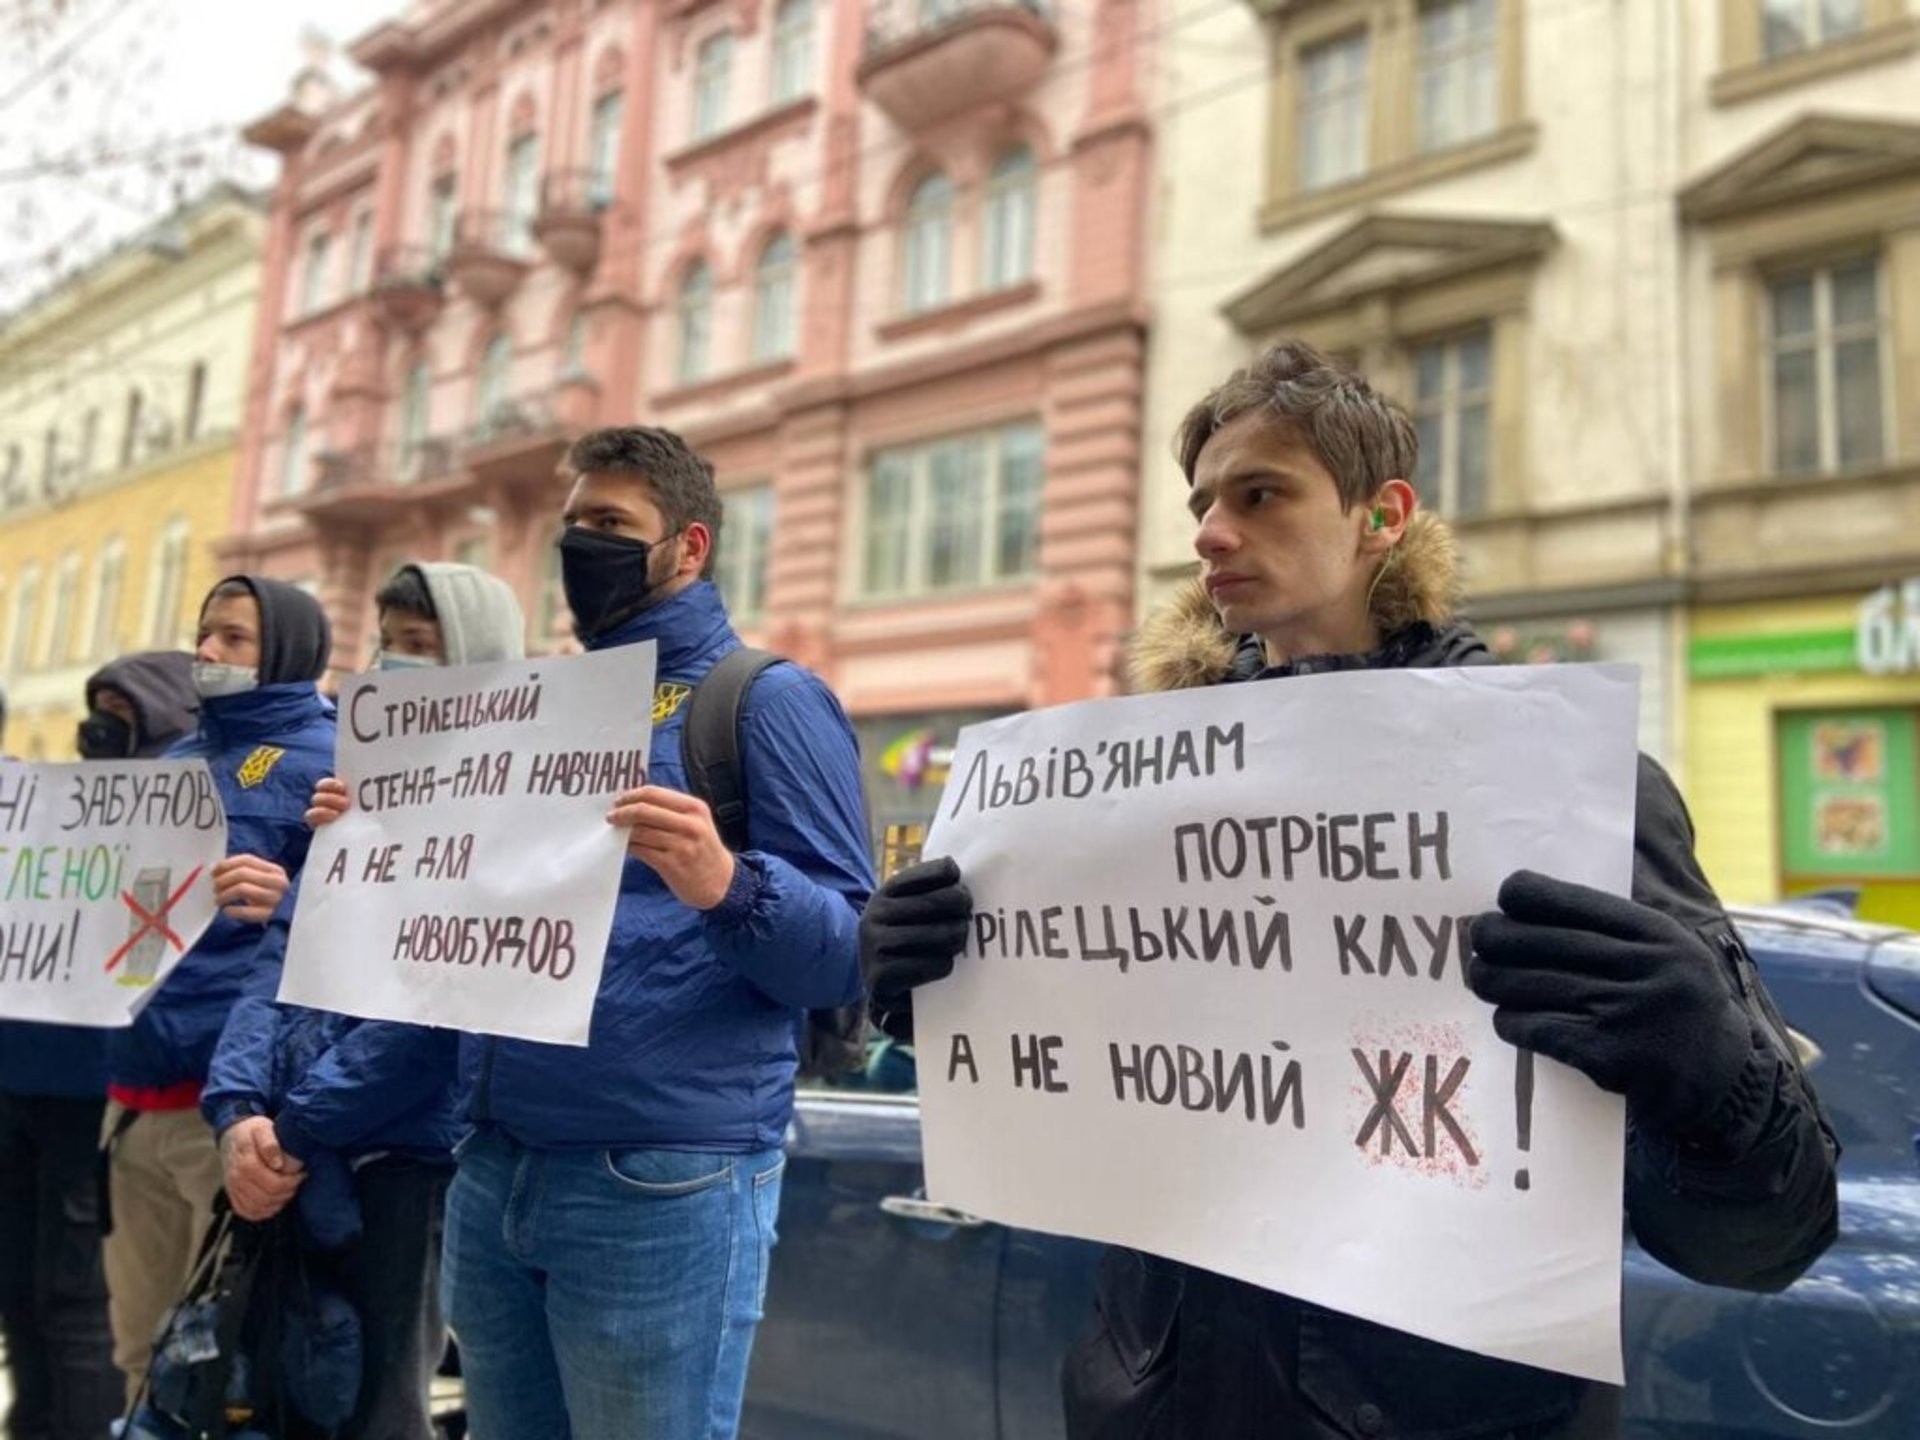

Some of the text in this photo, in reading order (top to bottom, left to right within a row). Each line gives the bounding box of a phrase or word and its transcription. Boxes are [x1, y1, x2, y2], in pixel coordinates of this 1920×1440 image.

[60, 770, 223, 831] ЗАБУДОВ
[0, 843, 130, 901] ЛЕНОЇ
[326, 833, 475, 884] А НЕ ДЛЯ
[0, 908, 81, 982] НИ!
[393, 914, 576, 981] НОВОБУДОВ
[962, 895, 1293, 973] РІЛЕЦЬКИЙ
[947, 1033, 979, 1083] А
[1012, 1035, 1068, 1093] НЕ
[1109, 1040, 1306, 1129] НОВИЙ
